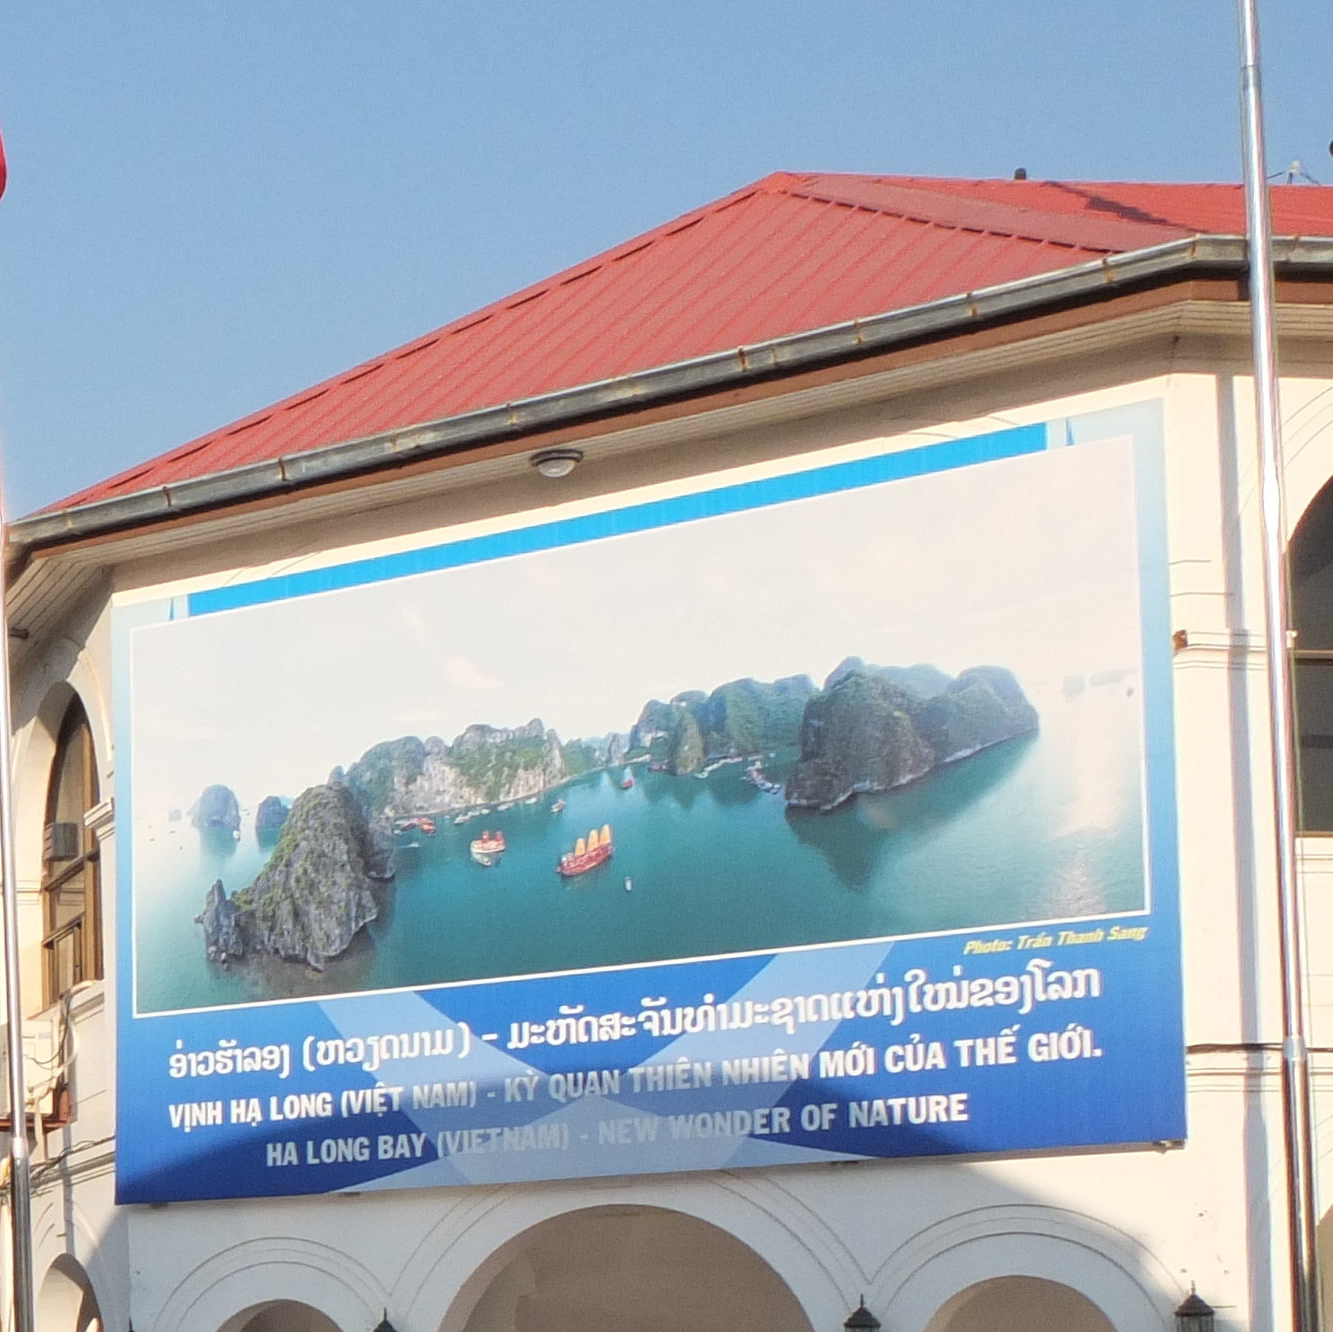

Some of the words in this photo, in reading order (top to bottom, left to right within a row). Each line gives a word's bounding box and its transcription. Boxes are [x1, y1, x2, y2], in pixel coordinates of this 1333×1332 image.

[963, 939, 1013, 955] Photo:
[1057, 928, 1104, 947] Thanh
[1107, 925, 1148, 942] Sang
[169, 1100, 222, 1132] VỊNH
[231, 1098, 263, 1127] HẠ
[270, 1093, 332, 1121] LONG
[341, 1082, 403, 1118] (VIỆT
[412, 1081, 476, 1109] NAM)
[505, 1069, 540, 1103] KỲ
[549, 1069, 620, 1103] QUAN
[628, 1057, 712, 1093] THIÊN
[722, 1048, 810, 1085] NHIÊN
[819, 1041, 875, 1078] MỚI
[884, 1033, 946, 1073] CỦA
[954, 1024, 1020, 1068] THẾ
[1028, 1023, 1103, 1062] GIỚI.
[266, 1140, 298, 1167] HA
[306, 1136, 370, 1165] LONG
[378, 1132, 427, 1161] BAY
[437, 1124, 569, 1160] (VIETNAM)
[598, 1115, 660, 1145] NEW
[672, 1107, 791, 1141] WONDER
[801, 1103, 838, 1131] OF
[848, 1093, 969, 1129] NATURE
